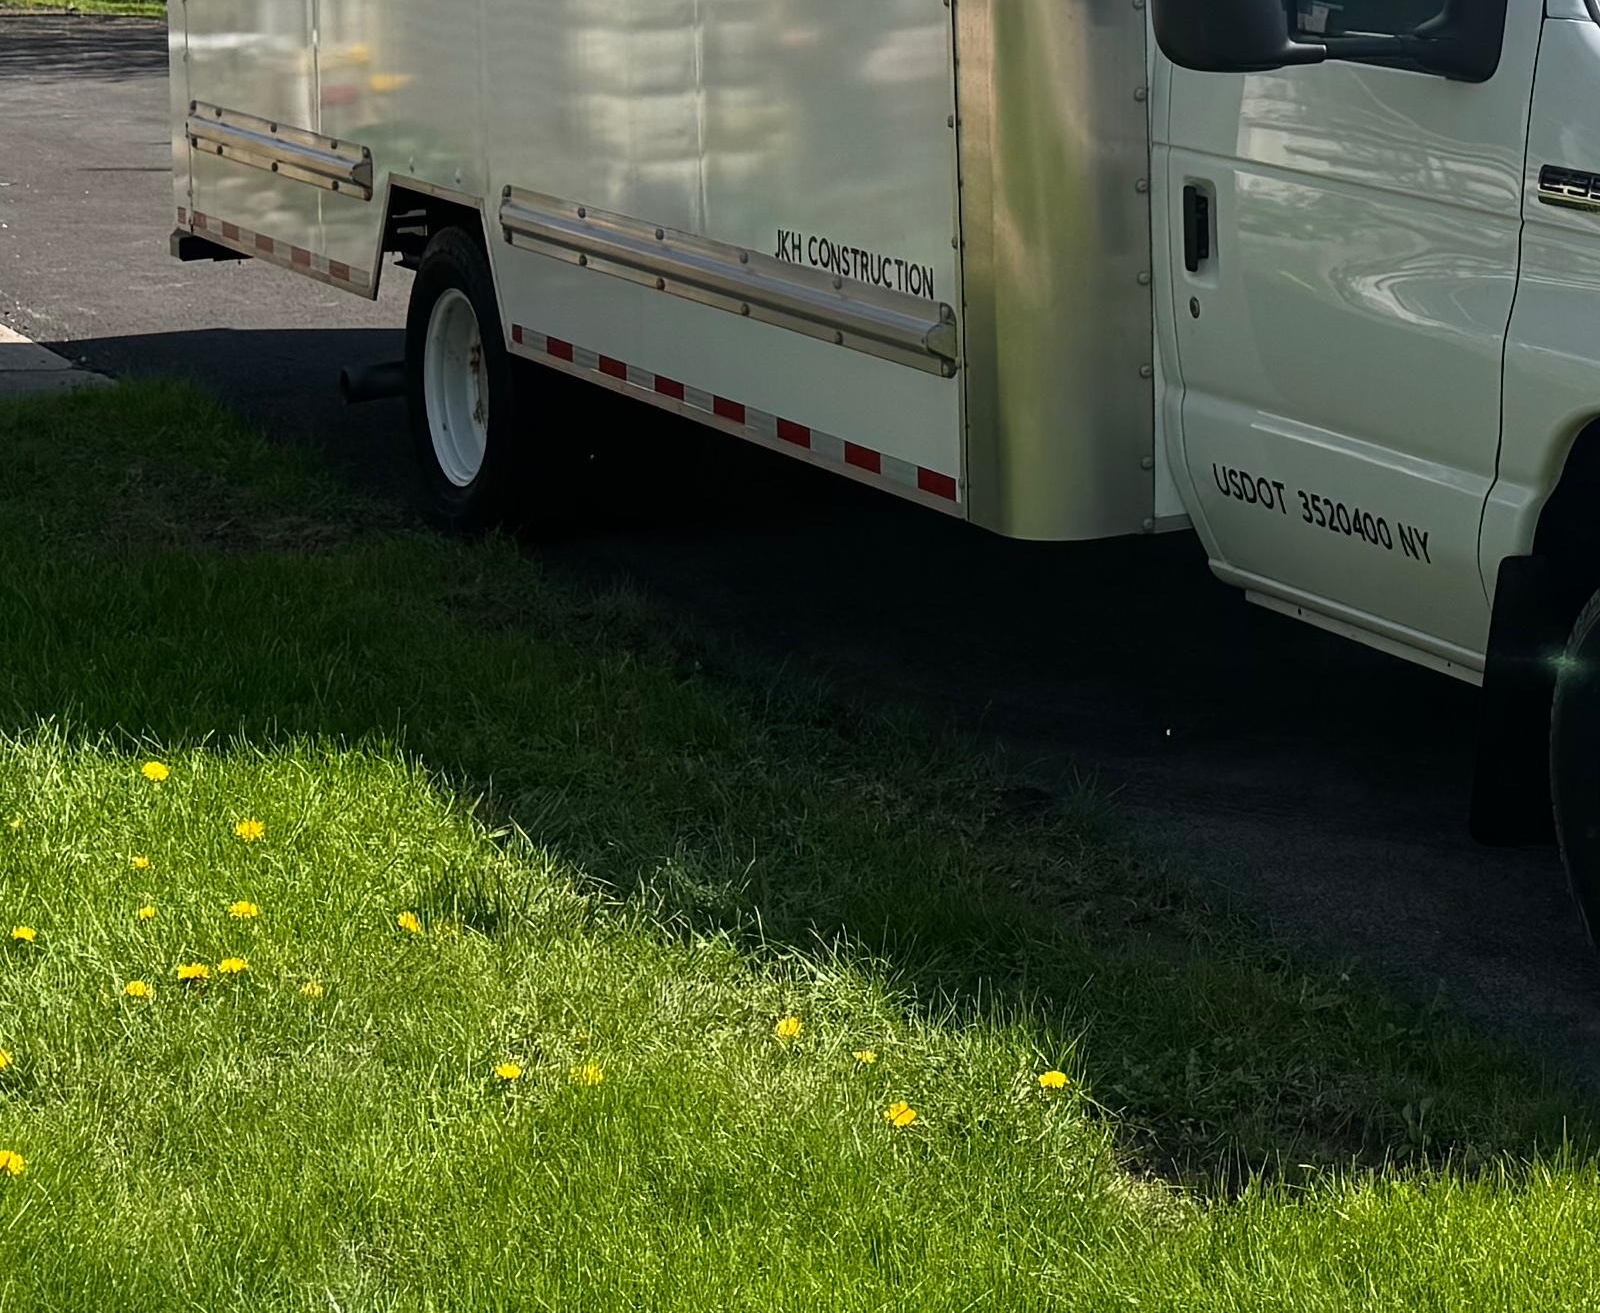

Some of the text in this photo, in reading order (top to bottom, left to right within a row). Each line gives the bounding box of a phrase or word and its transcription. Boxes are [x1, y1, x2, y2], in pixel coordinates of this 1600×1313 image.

[775, 229, 934, 300] JKH CONSTRUCTION
[1212, 463, 1431, 564] USDOT 3520400 NY
